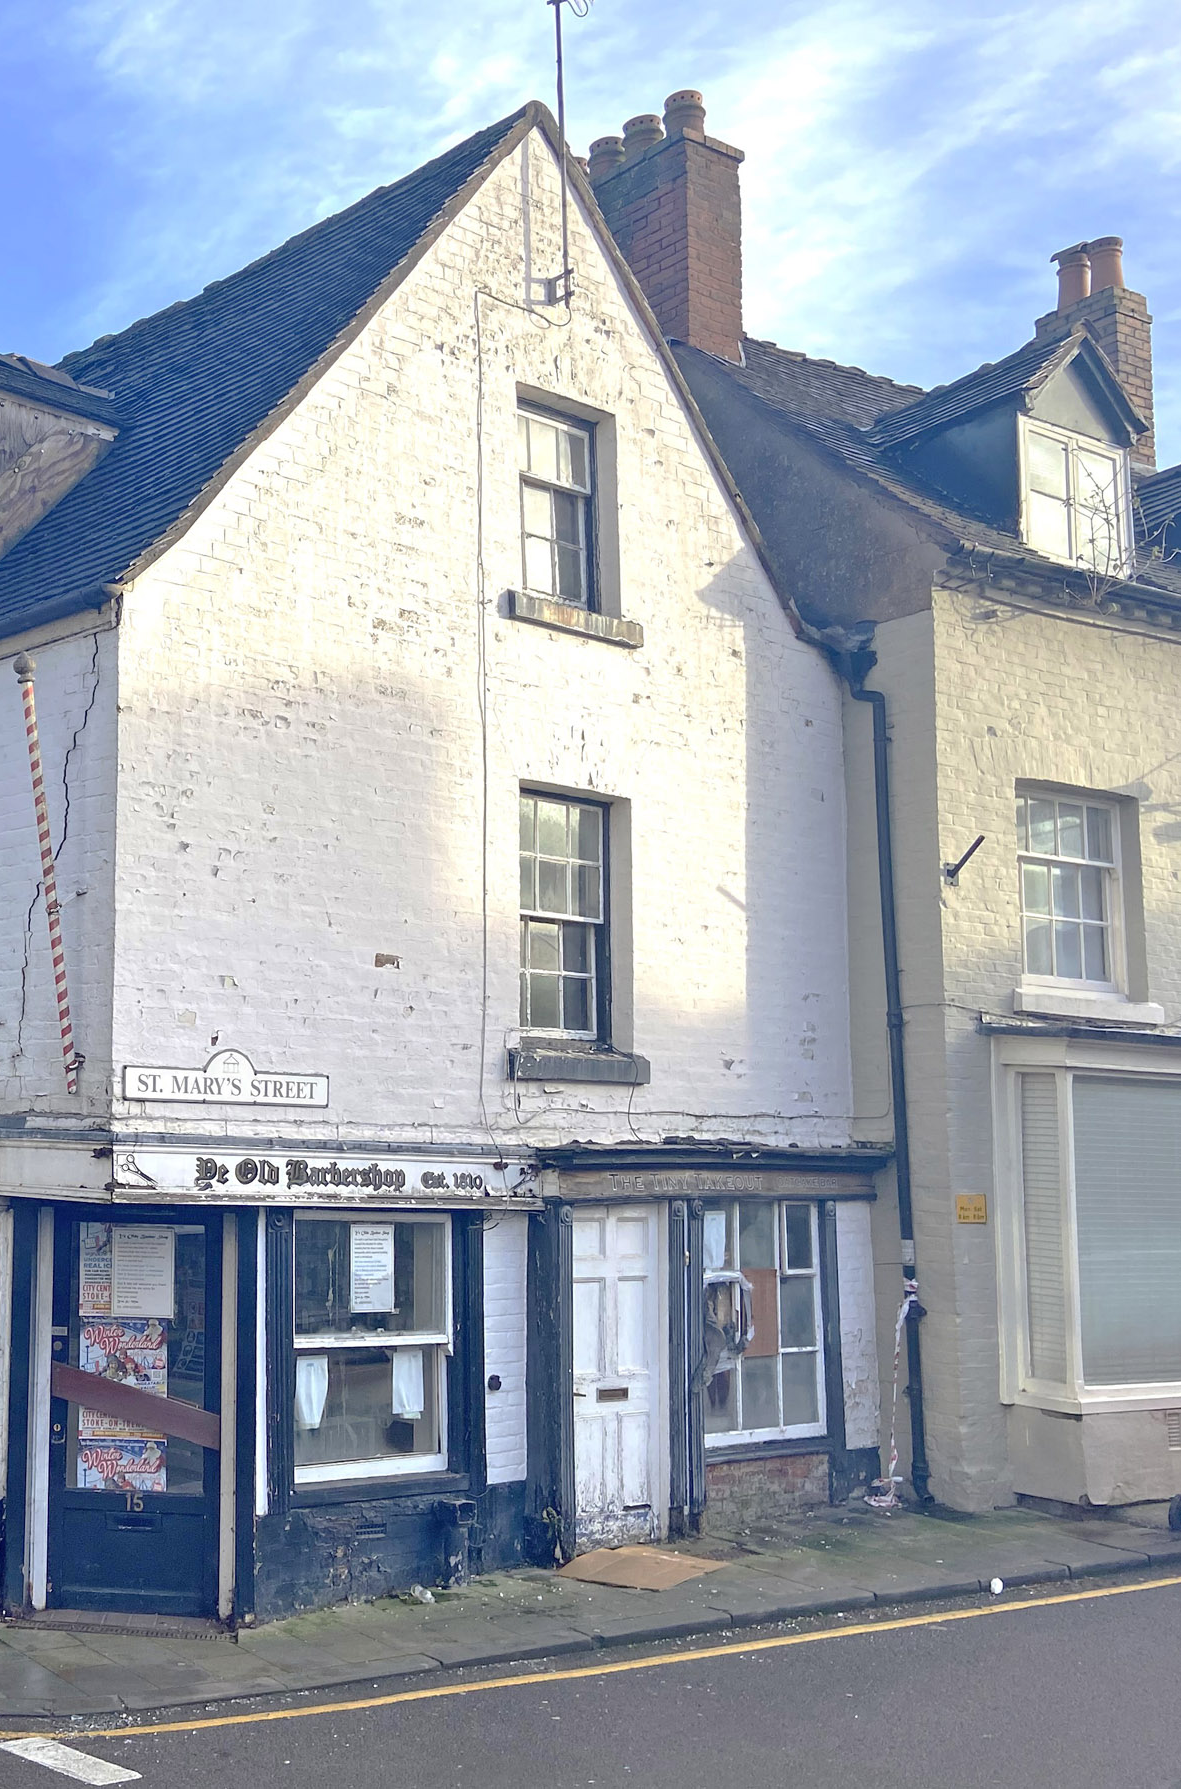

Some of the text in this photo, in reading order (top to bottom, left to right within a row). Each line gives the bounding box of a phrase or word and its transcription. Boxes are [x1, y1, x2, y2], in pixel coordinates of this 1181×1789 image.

[137, 1073, 318, 1100] ST. MARY'S STREET
[194, 1157, 483, 1192] Ye Old Barbershop Est. 1810
[608, 1173, 645, 1191] THE
[649, 1172, 689, 1192] TINY
[693, 1173, 763, 1191] TAKEOUT
[820, 1177, 838, 1189] BAR
[82, 1284, 96, 1292] CITY
[84, 1324, 125, 1346] Winter
[100, 1335, 162, 1357] Wonderland
[82, 1410, 96, 1419] CITY
[82, 1448, 123, 1471] Winter
[98, 1459, 160, 1480] Wonderland
[125, 1492, 144, 1512] 15
